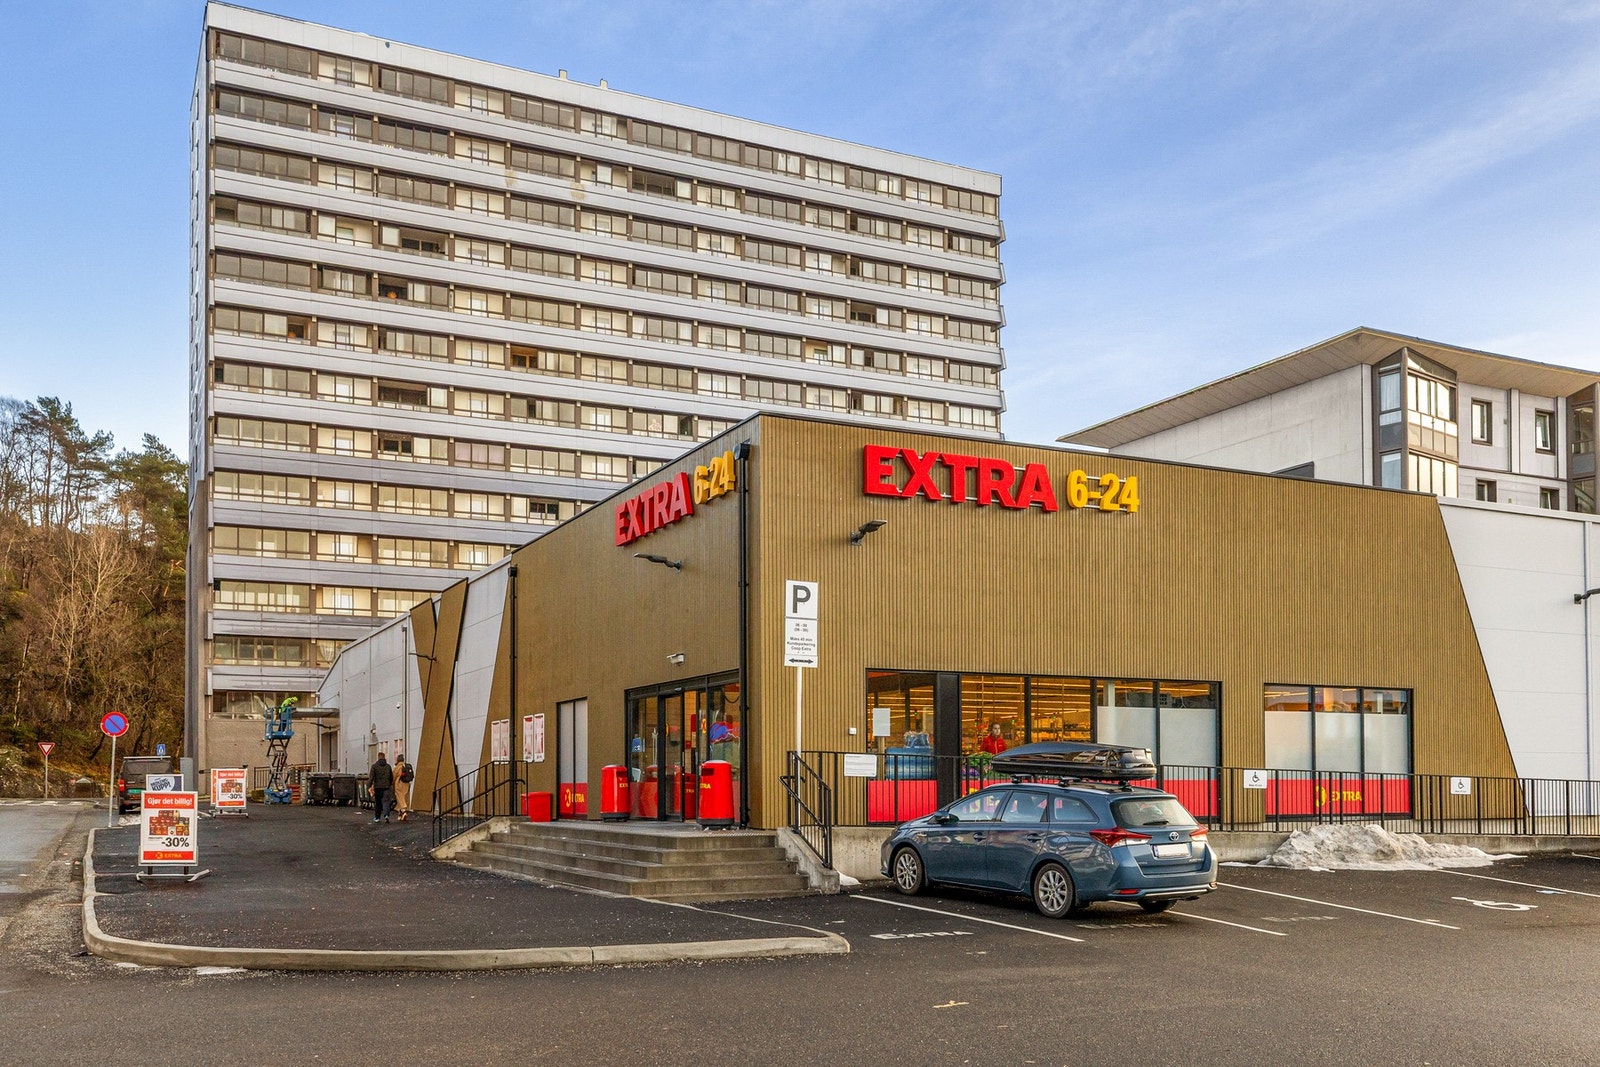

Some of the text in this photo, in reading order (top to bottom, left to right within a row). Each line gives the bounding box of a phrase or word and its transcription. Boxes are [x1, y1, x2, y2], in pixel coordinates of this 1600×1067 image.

[864, 444, 1140, 513] EXTRA 6-24
[615, 450, 735, 547] EXTRA 6-24
[793, 585, 811, 614] P
[147, 797, 193, 806] Gjør det billig!
[161, 837, 189, 848] -30%
